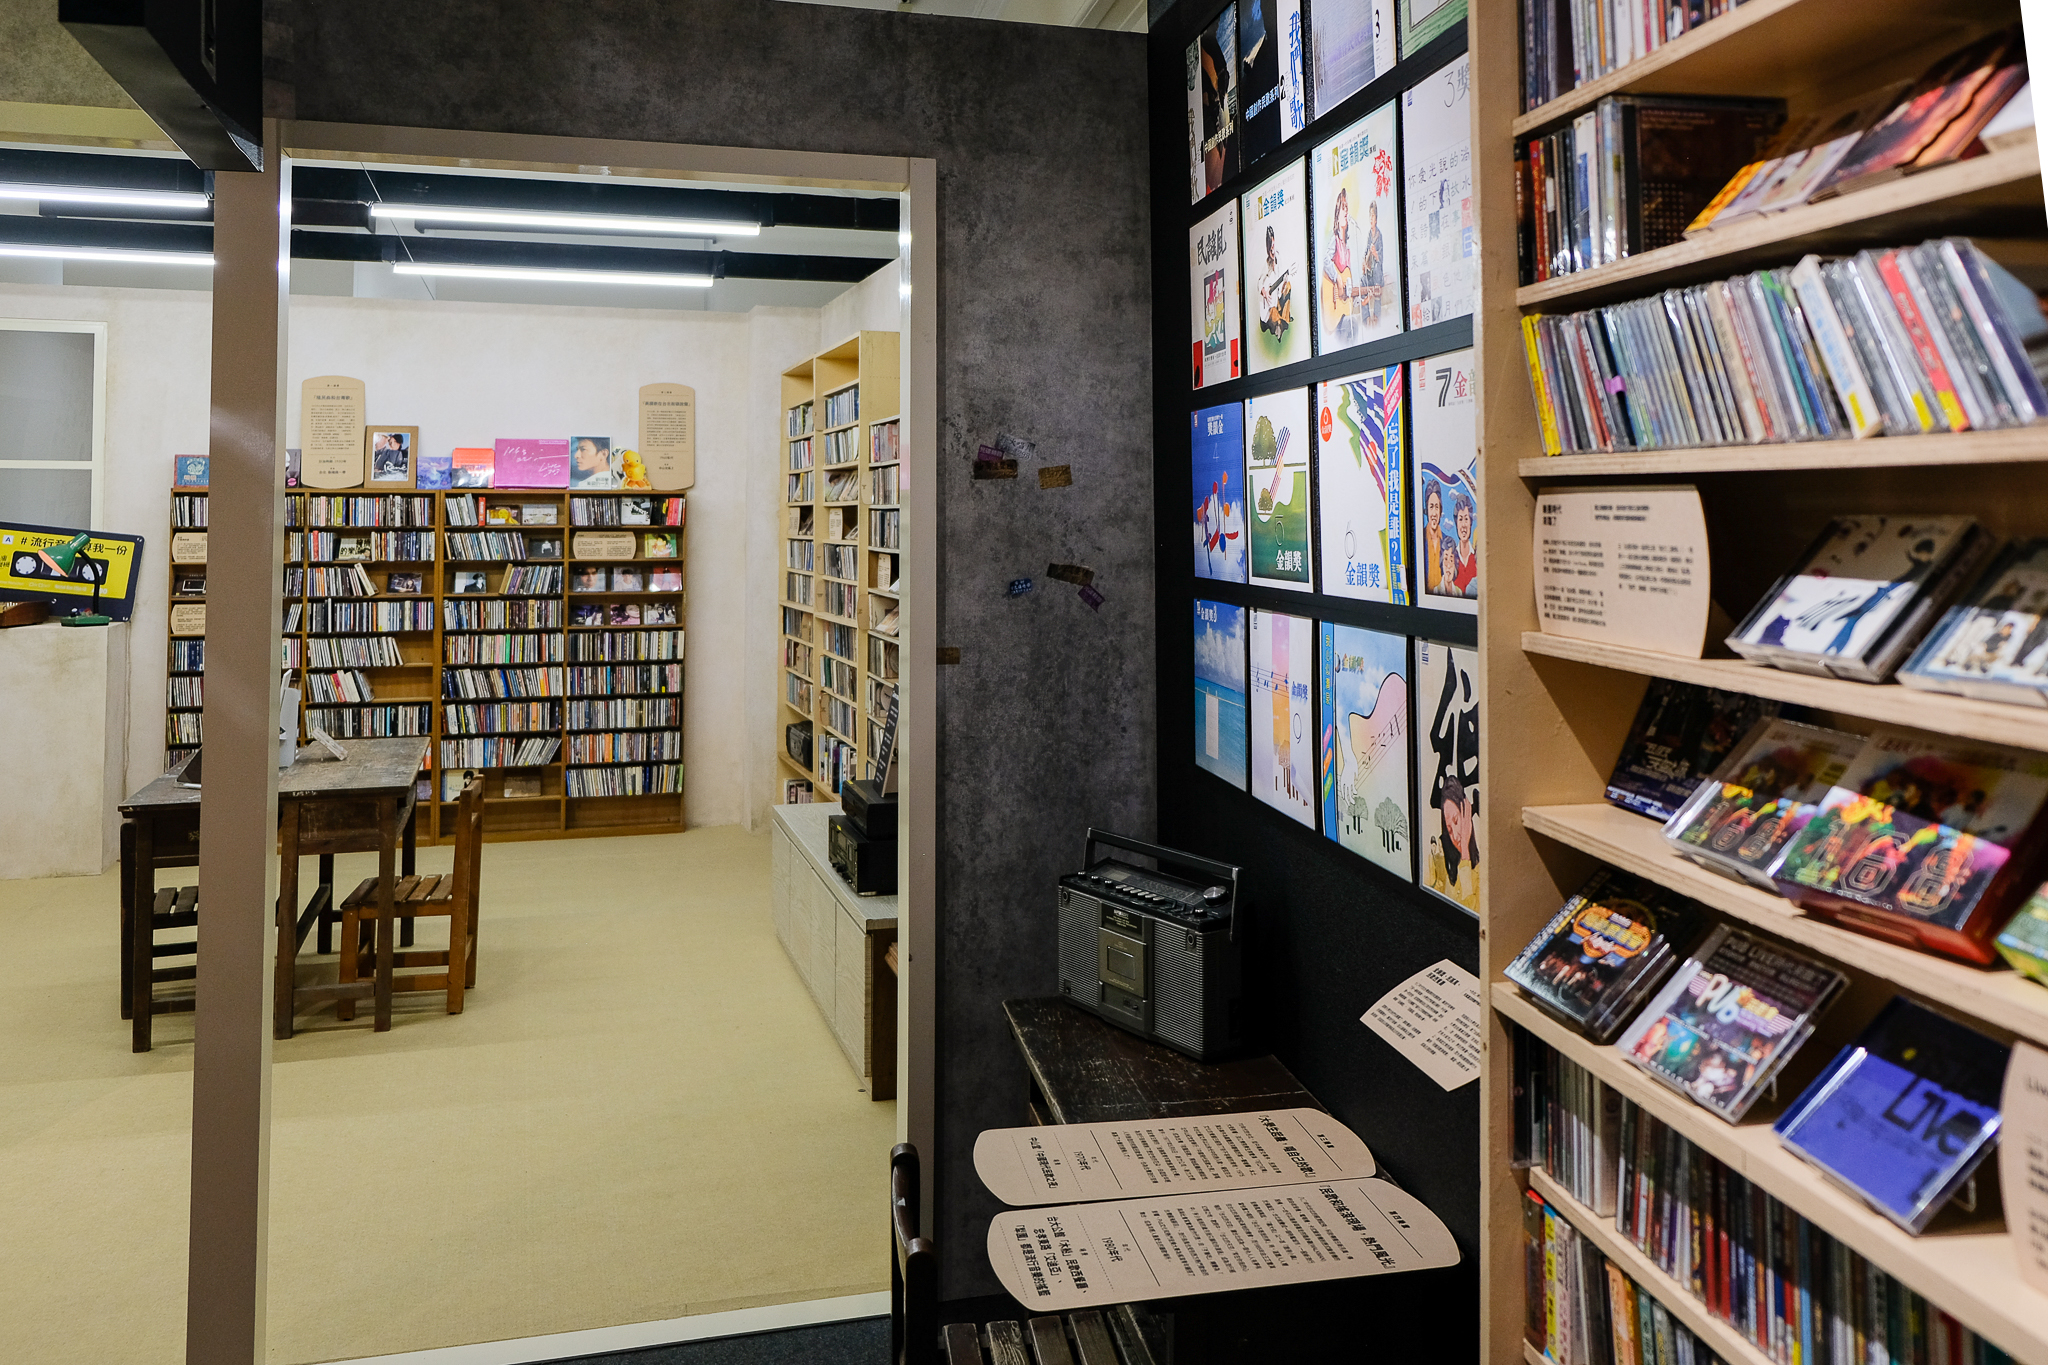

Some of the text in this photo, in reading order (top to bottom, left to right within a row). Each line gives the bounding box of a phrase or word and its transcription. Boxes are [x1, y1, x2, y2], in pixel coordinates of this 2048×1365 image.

[1289, 10, 1305, 130] 我們的歌
[1245, 83, 1280, 122] 中國創作民歌系列
[1280, 74, 1286, 101] 2
[1204, 120, 1234, 154] 中國創作民歌系列
[1340, 134, 1369, 172] 金韻獎
[1435, 367, 1451, 408] 7
[1275, 549, 1302, 573] 金韻獎
[1345, 561, 1380, 589] 金韻獎
[1072, 1151, 1091, 1170] 1970年代
[1100, 1237, 1123, 1262] 1980年代
